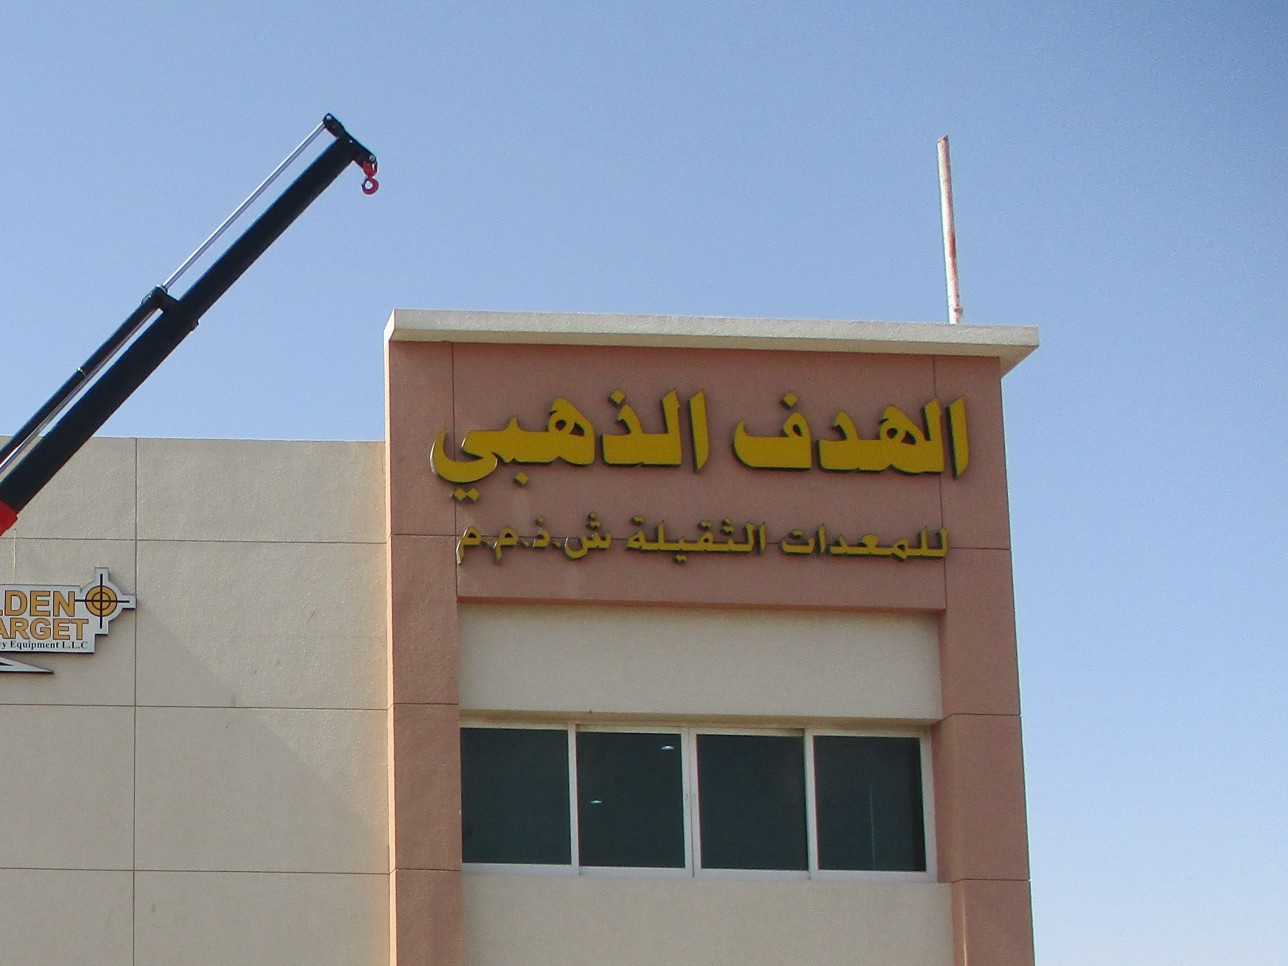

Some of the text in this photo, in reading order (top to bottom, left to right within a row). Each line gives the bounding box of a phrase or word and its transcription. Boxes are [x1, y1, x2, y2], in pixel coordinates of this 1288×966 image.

[429, 387, 969, 502] الهدف الذهبي
[625, 515, 767, 562] الثقيلة
[779, 526, 950, 560] للمعدات
[10, 639, 59, 650] Equipment
[62, 641, 88, 649] L.L.C
